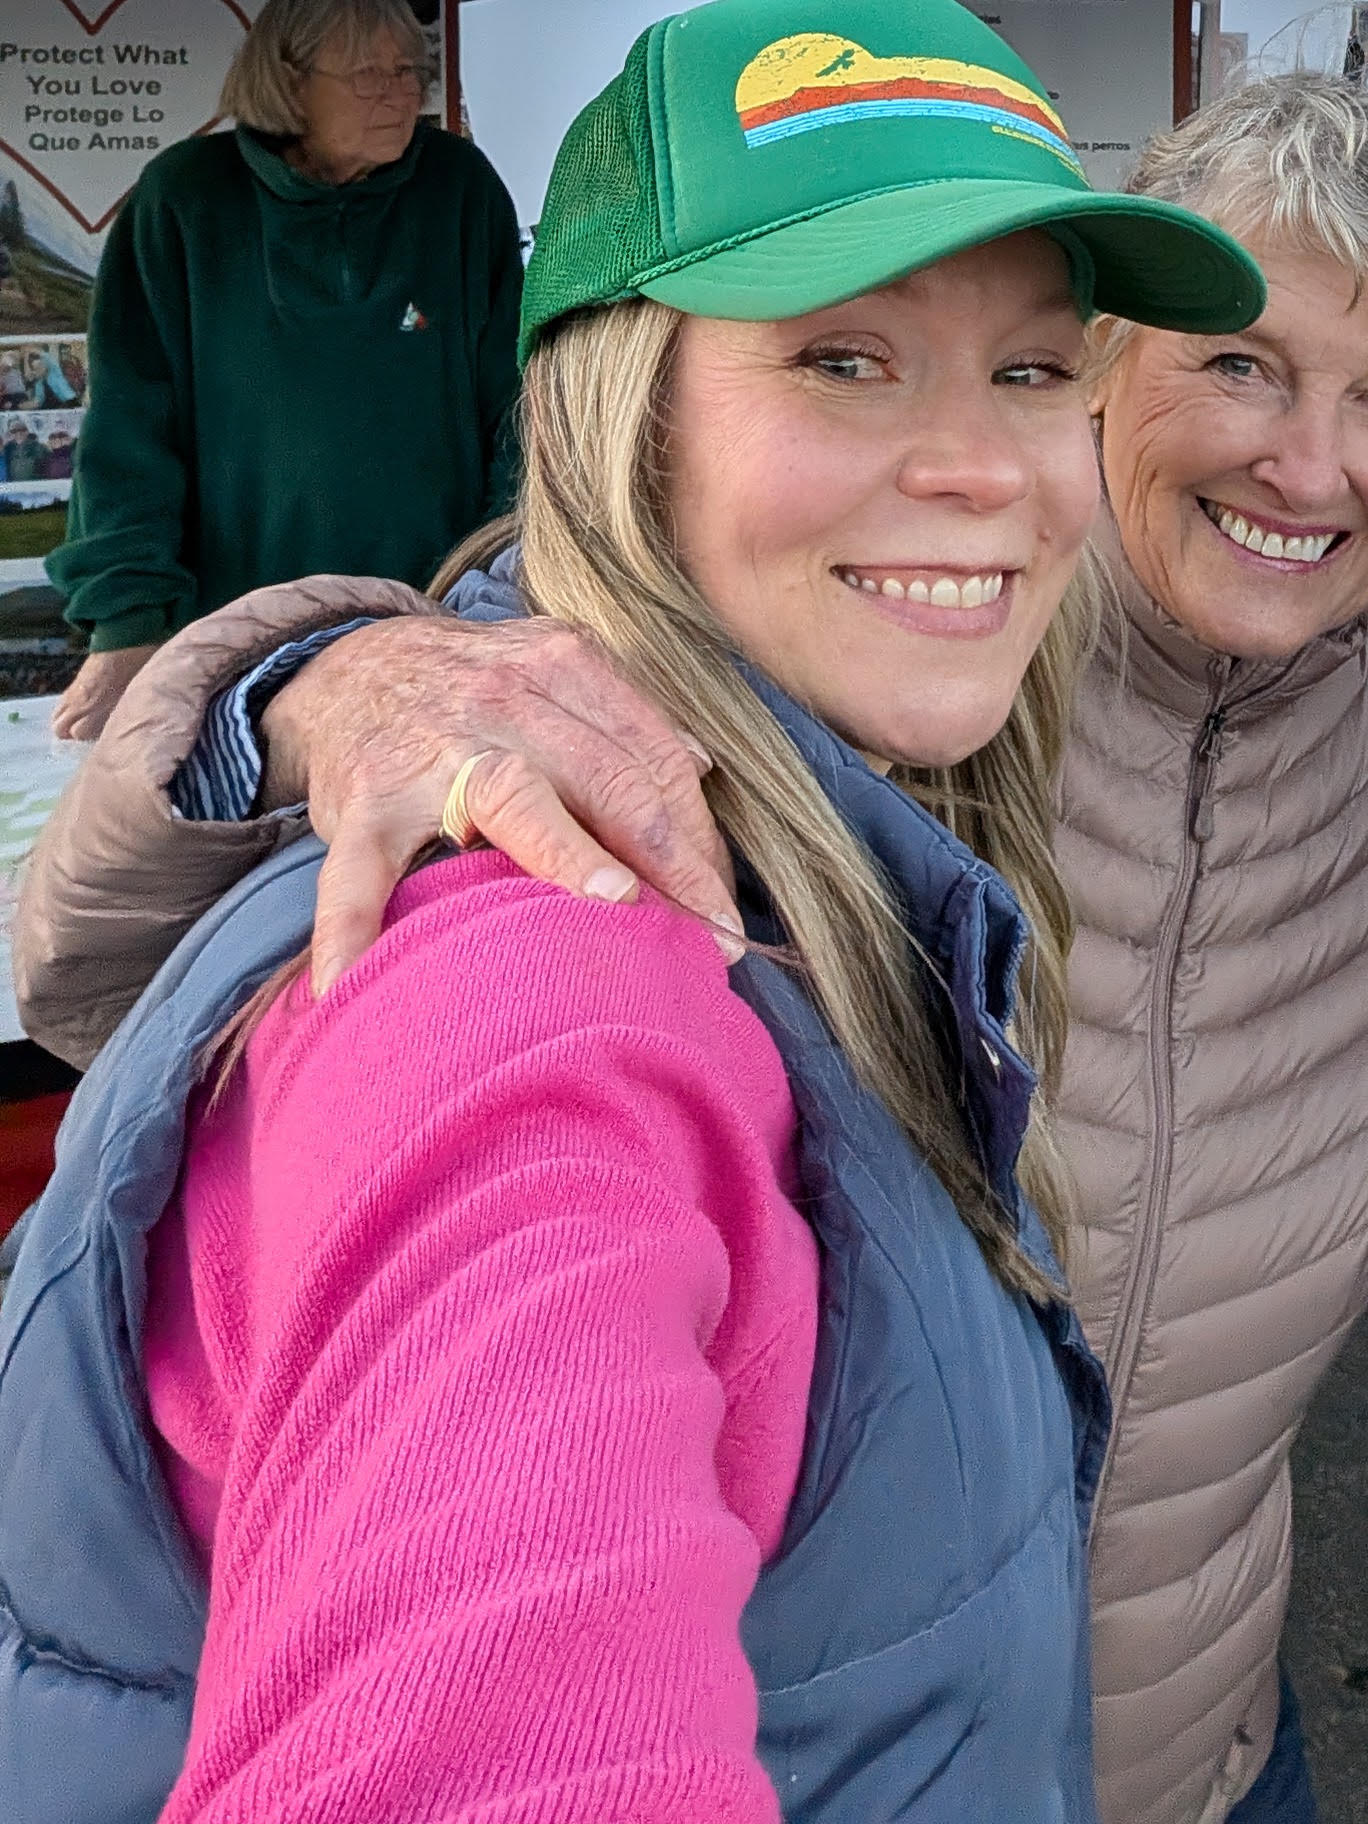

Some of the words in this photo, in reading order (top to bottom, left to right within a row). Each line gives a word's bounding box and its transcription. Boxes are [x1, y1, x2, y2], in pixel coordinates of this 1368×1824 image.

[0, 43, 105, 65] Protect
[113, 44, 189, 65] What
[26, 75, 81, 96] You
[92, 75, 162, 96] Love
[25, 104, 124, 126] Protege
[132, 105, 164, 123] Lo
[28, 132, 81, 151] Que
[88, 132, 161, 150] Amas
[1092, 141, 1131, 153] perros
